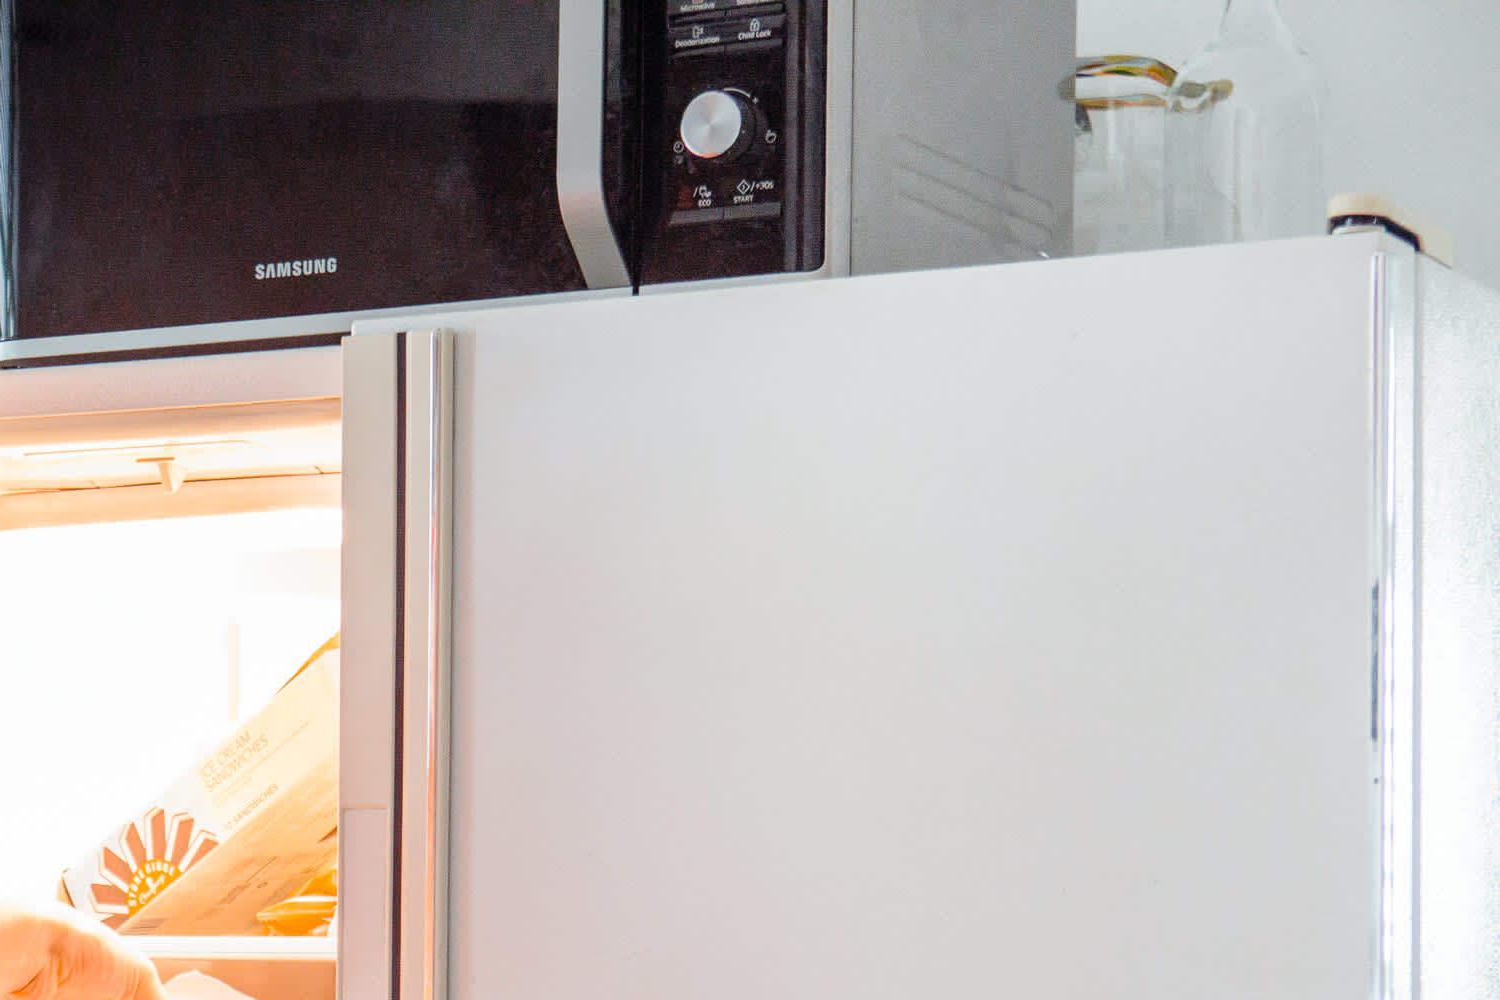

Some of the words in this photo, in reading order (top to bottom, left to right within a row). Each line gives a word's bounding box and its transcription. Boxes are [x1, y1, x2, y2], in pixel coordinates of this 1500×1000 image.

[738, 31, 755, 41] Child
[756, 29, 772, 38] Lock
[698, 199, 712, 207] ECO
[733, 194, 754, 204] START
[254, 257, 338, 280] SAMSUNG
